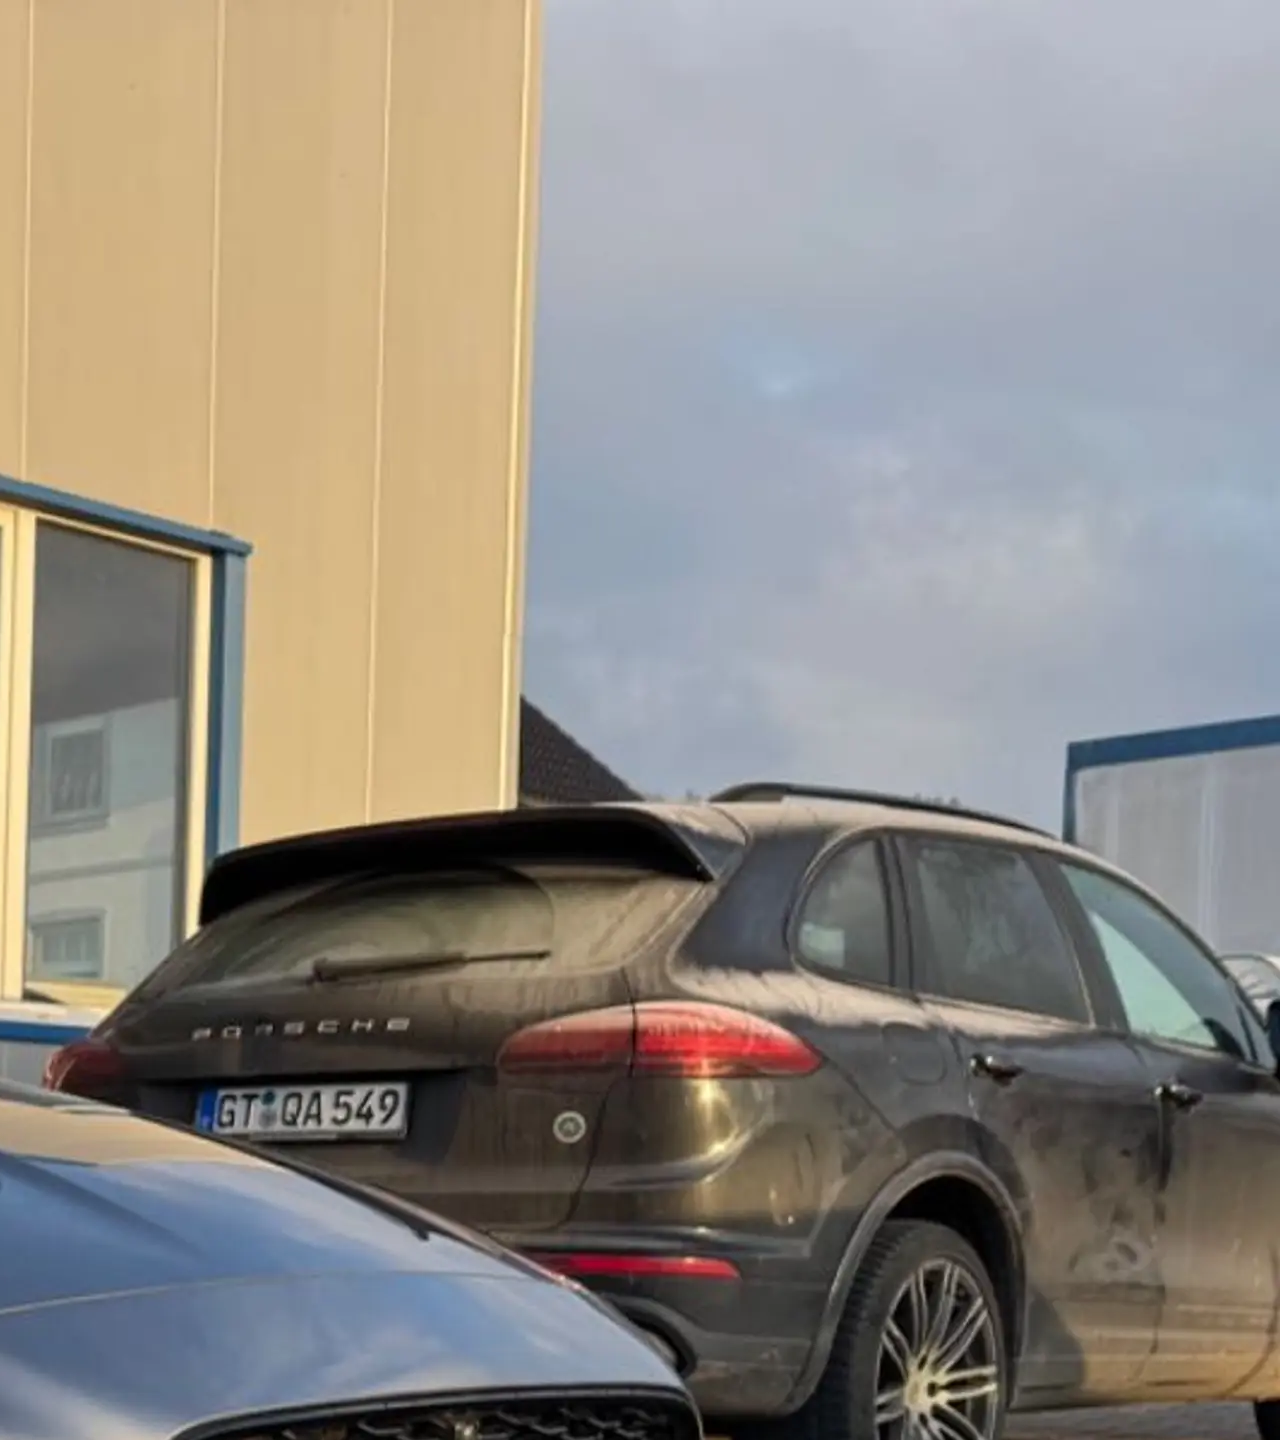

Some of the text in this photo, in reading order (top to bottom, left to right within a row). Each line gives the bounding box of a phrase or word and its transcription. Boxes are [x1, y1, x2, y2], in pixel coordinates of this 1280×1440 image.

[192, 1017, 410, 1041] PORSCHE
[217, 1088, 400, 1129] GT QA 549
